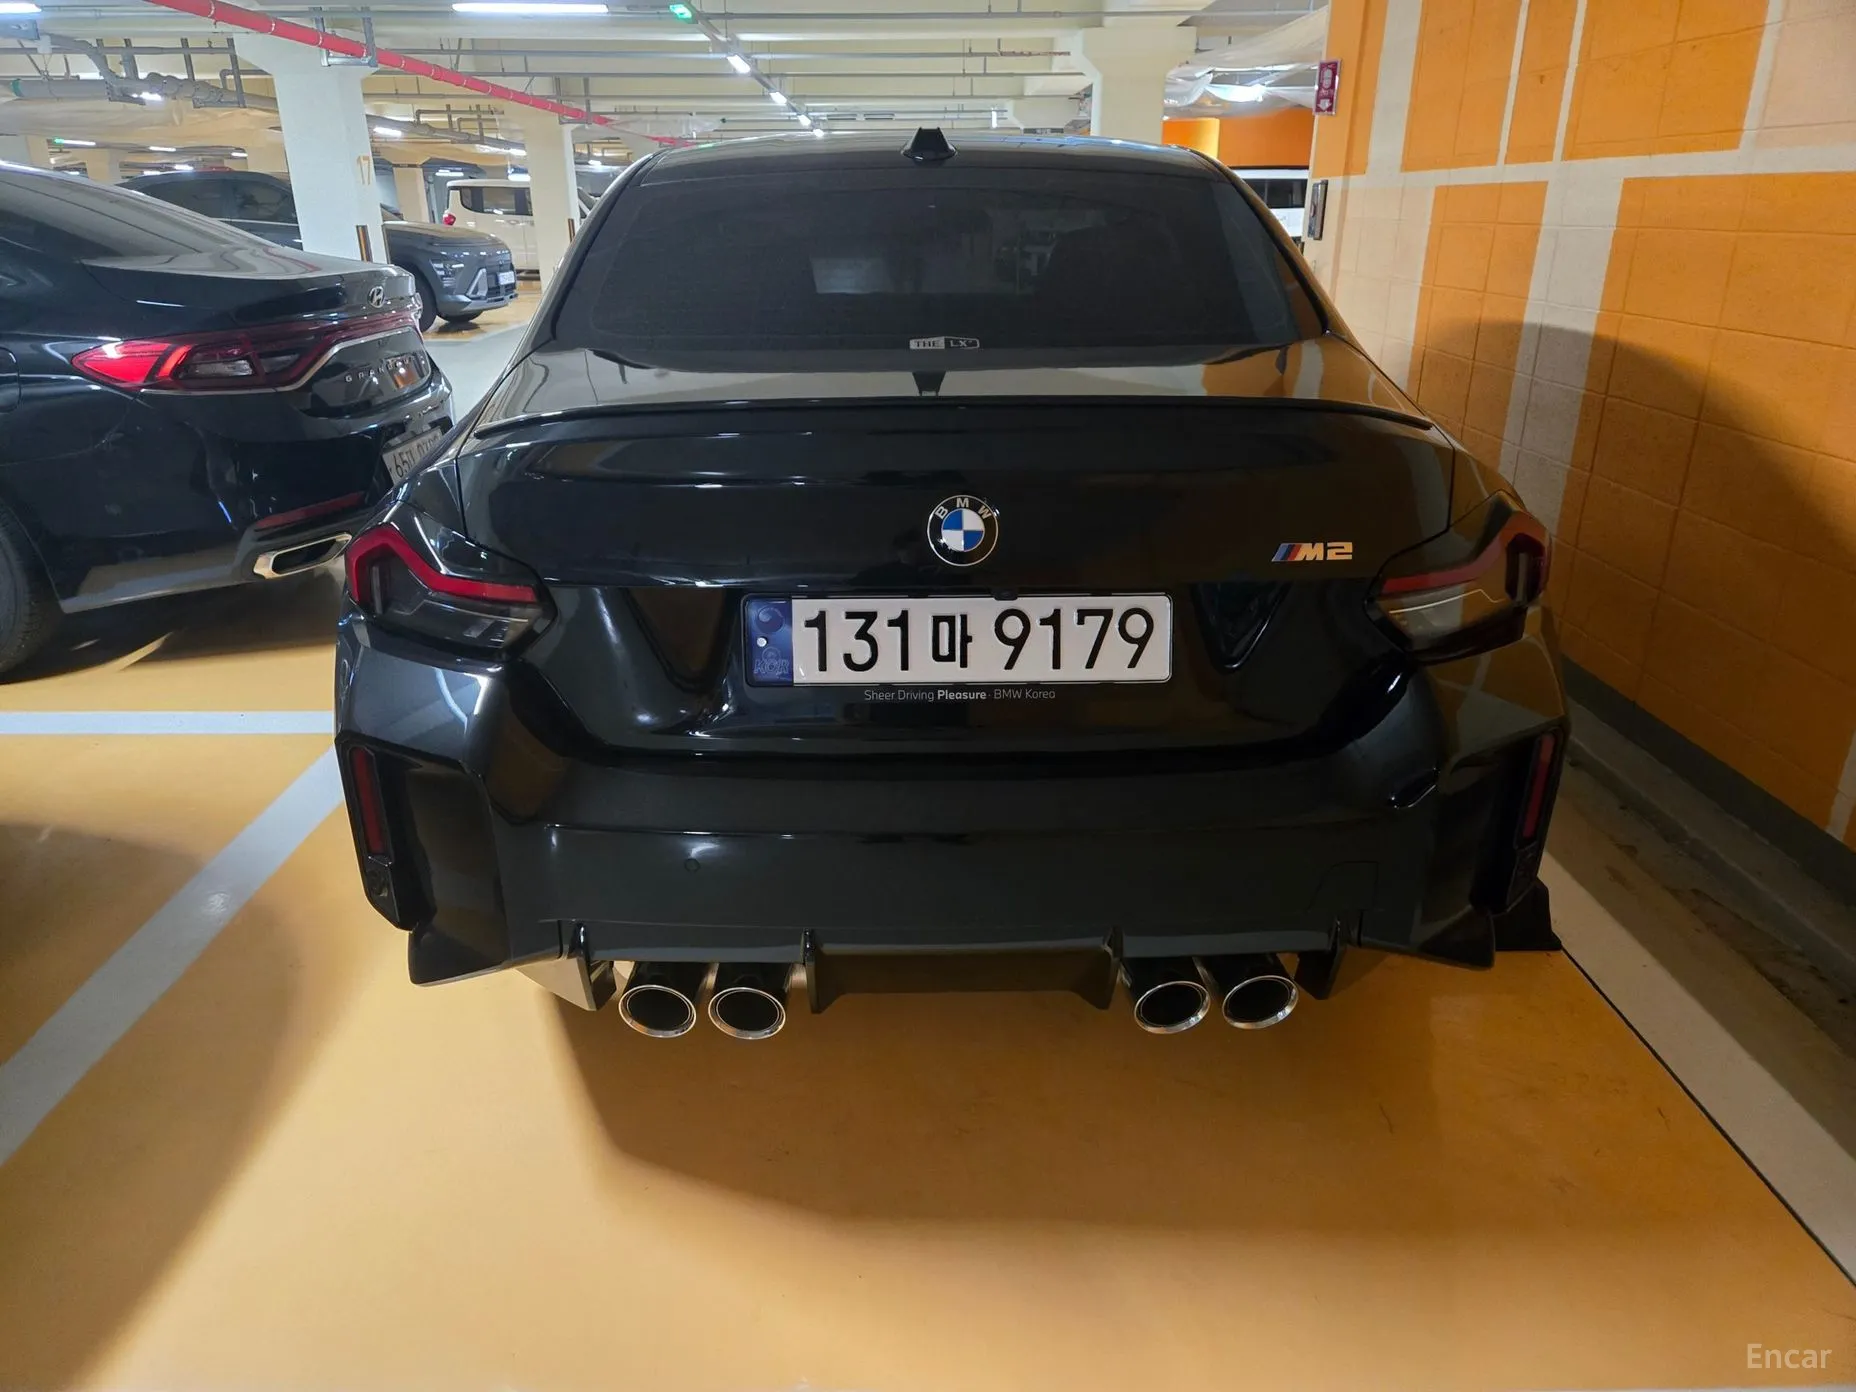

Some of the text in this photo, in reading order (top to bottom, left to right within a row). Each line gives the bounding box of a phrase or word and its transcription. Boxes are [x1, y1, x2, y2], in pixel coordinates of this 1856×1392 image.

[934, 497, 993, 520] BMW
[803, 606, 1156, 673] 131마 9179
[864, 688, 1056, 702] Sheer Driving Pleasure BMW Korea
